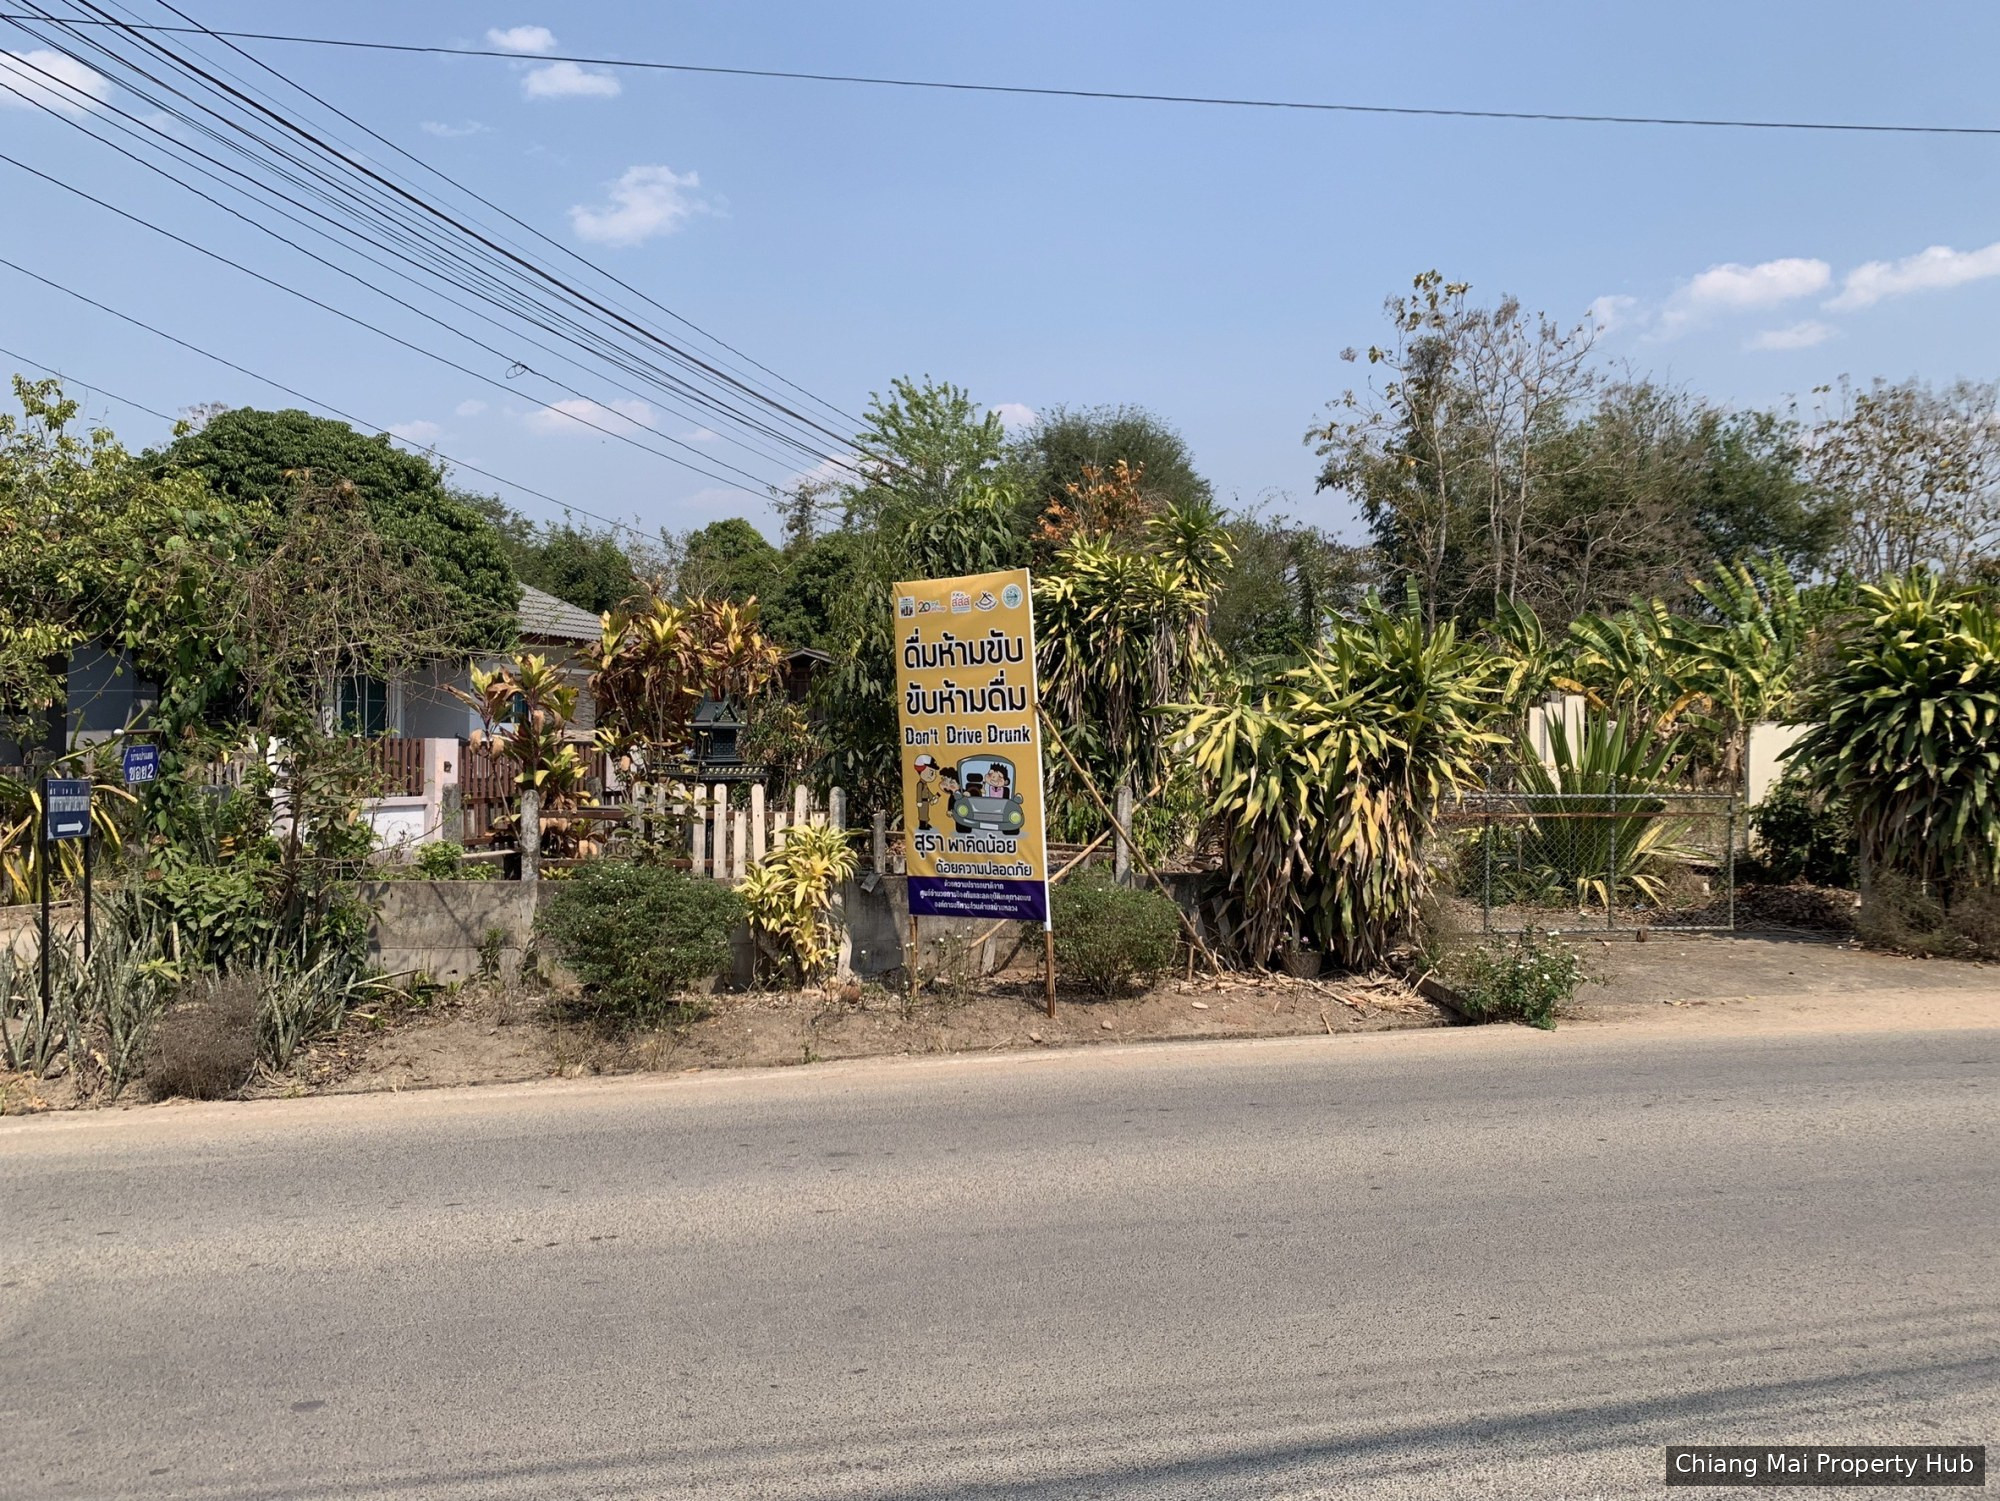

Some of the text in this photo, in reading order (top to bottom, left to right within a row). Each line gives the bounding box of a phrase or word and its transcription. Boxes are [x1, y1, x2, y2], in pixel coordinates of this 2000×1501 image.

[904, 628, 1023, 668] ดื่มห้ามขับ
[906, 670, 1026, 714] ขับห้ามดื่ม
[905, 725, 1030, 745] Don't Drive Drunk
[914, 833, 1016, 858] สุรา พาคิดน้อย
[936, 859, 1032, 877] ด้อยความปลอดภัย
